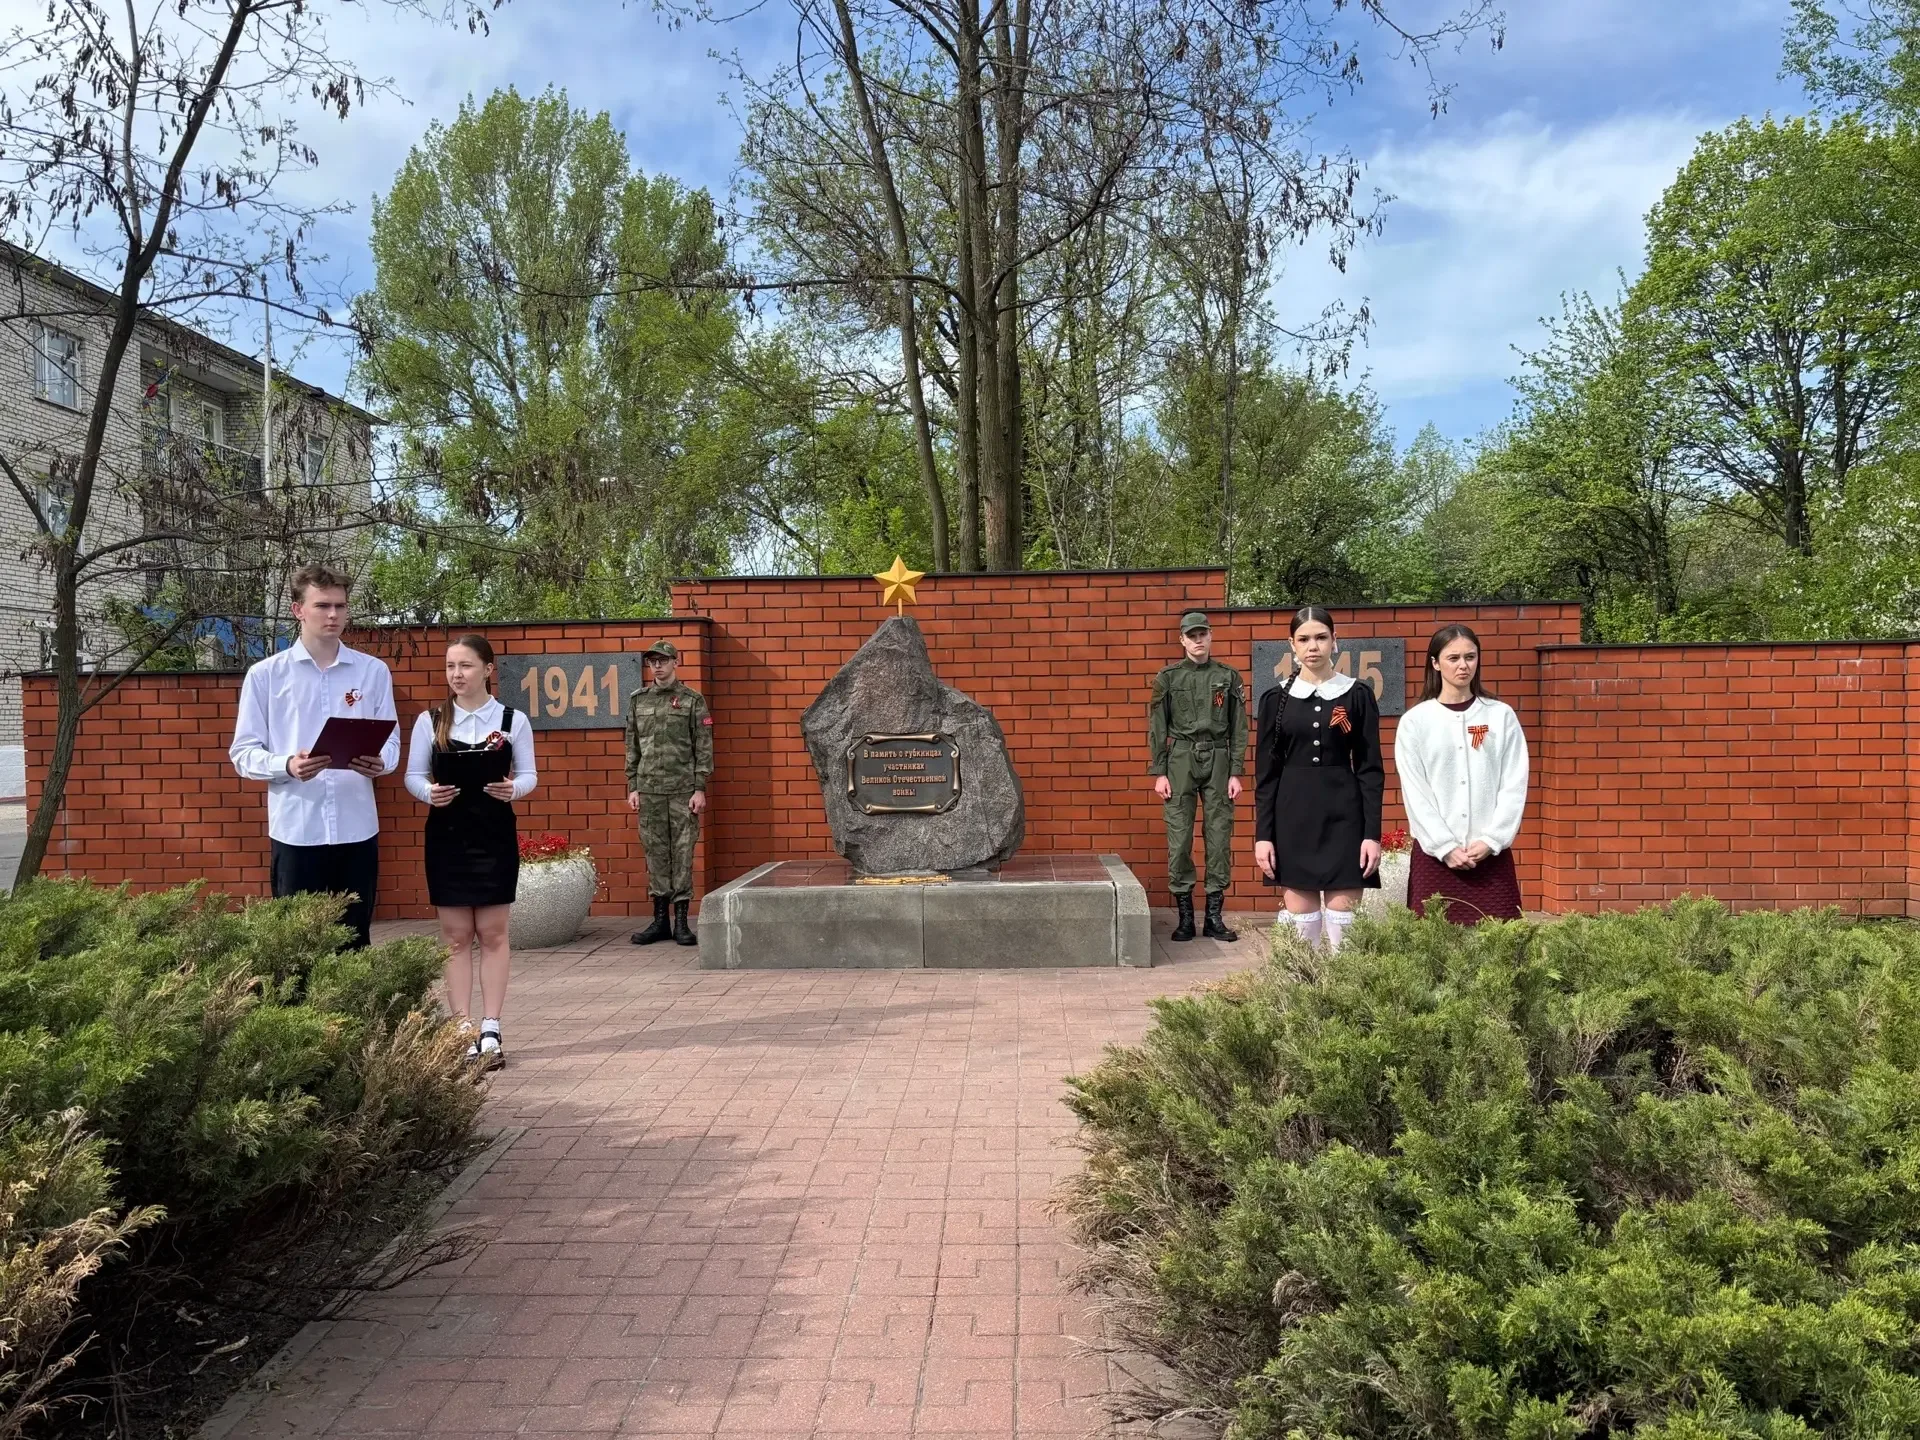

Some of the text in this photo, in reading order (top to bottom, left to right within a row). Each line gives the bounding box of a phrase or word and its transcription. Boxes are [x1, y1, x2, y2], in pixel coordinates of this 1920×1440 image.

[520, 664, 620, 718] 1941
[863, 749, 869, 758] В
[870, 749, 897, 758] память
[883, 763, 925, 772] участниках
[861, 774, 947, 784] Великой Отечественной
[893, 787, 915, 796] войны
